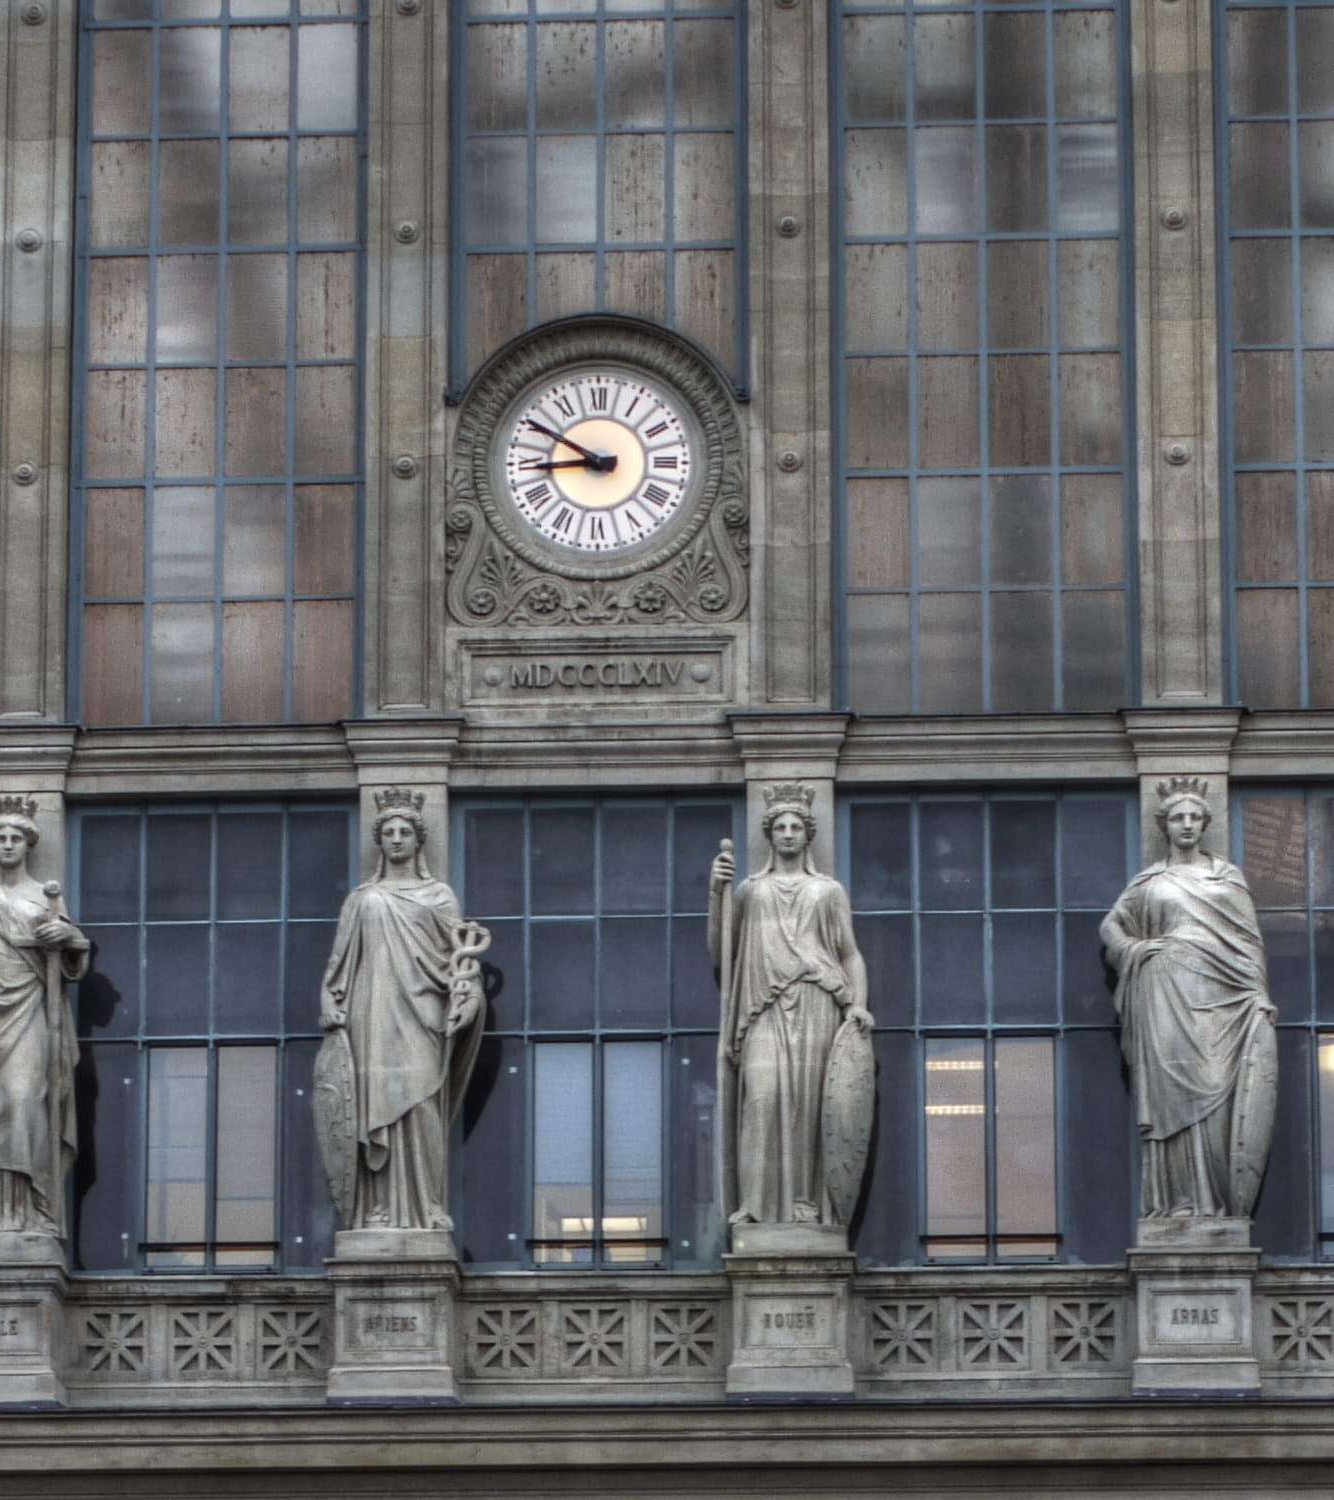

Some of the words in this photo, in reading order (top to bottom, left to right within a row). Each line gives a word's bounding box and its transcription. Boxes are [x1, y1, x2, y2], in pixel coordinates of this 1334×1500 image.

[589, 387, 608, 411] XII
[645, 421, 670, 438] II
[653, 456, 678, 469] III
[510, 661, 685, 688] MDCCCLXIV
[1171, 1308, 1219, 1325] ARRAS
